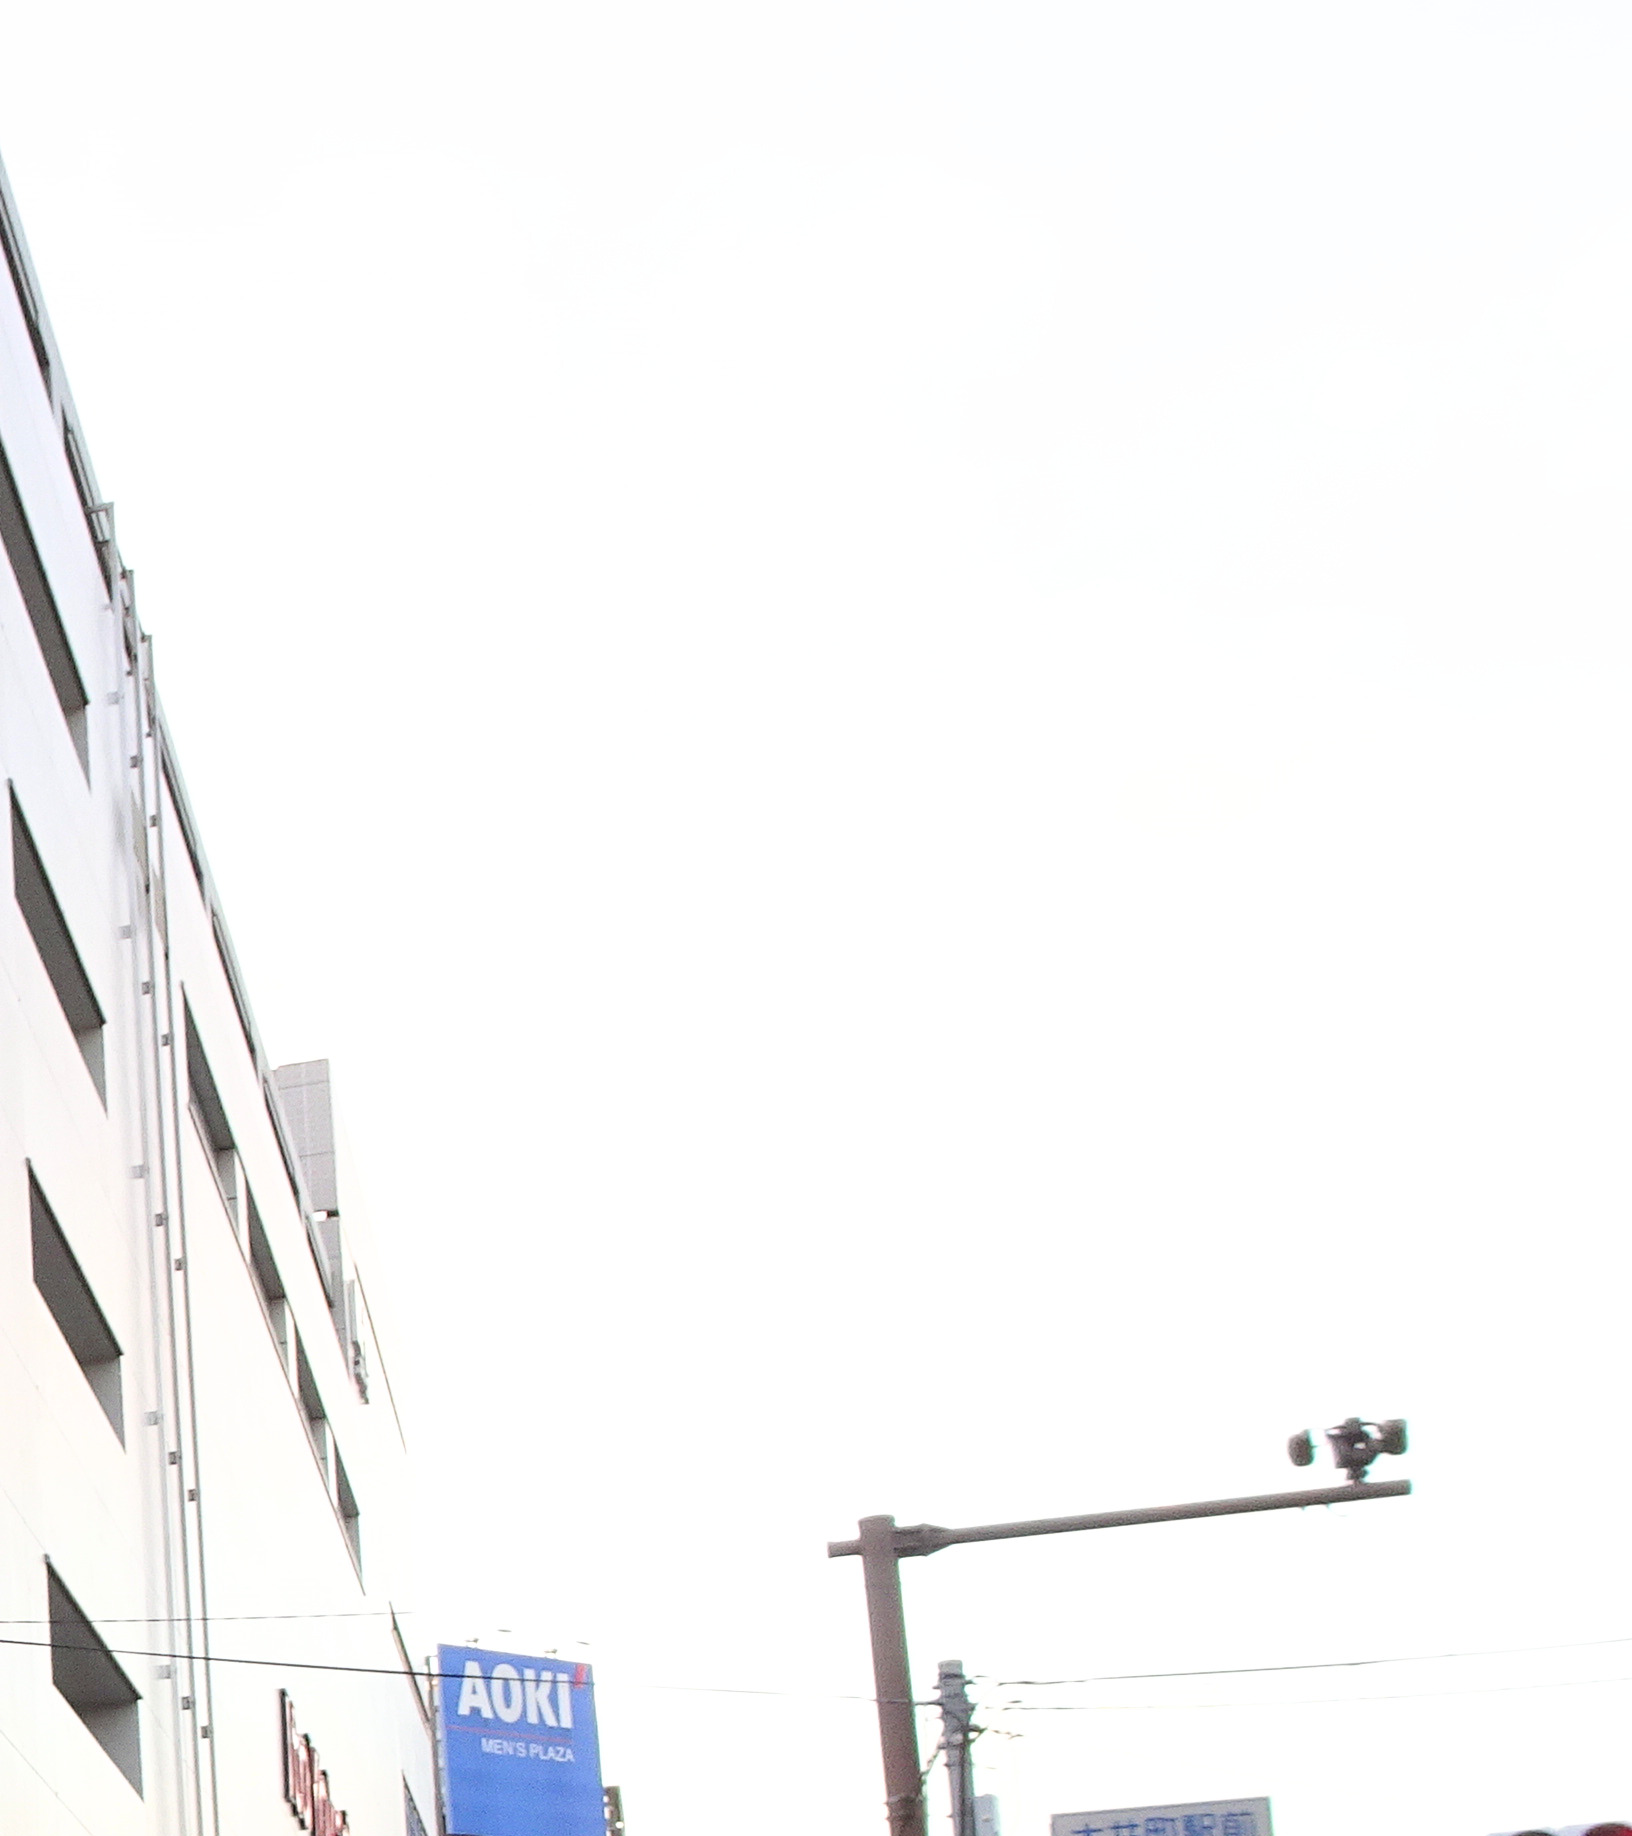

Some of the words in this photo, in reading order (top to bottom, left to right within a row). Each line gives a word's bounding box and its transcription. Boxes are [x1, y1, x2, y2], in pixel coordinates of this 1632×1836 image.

[457, 1660, 573, 1729] AOKI
[481, 1737, 526, 1758] MEN'S
[528, 1743, 575, 1762] PLAZA
